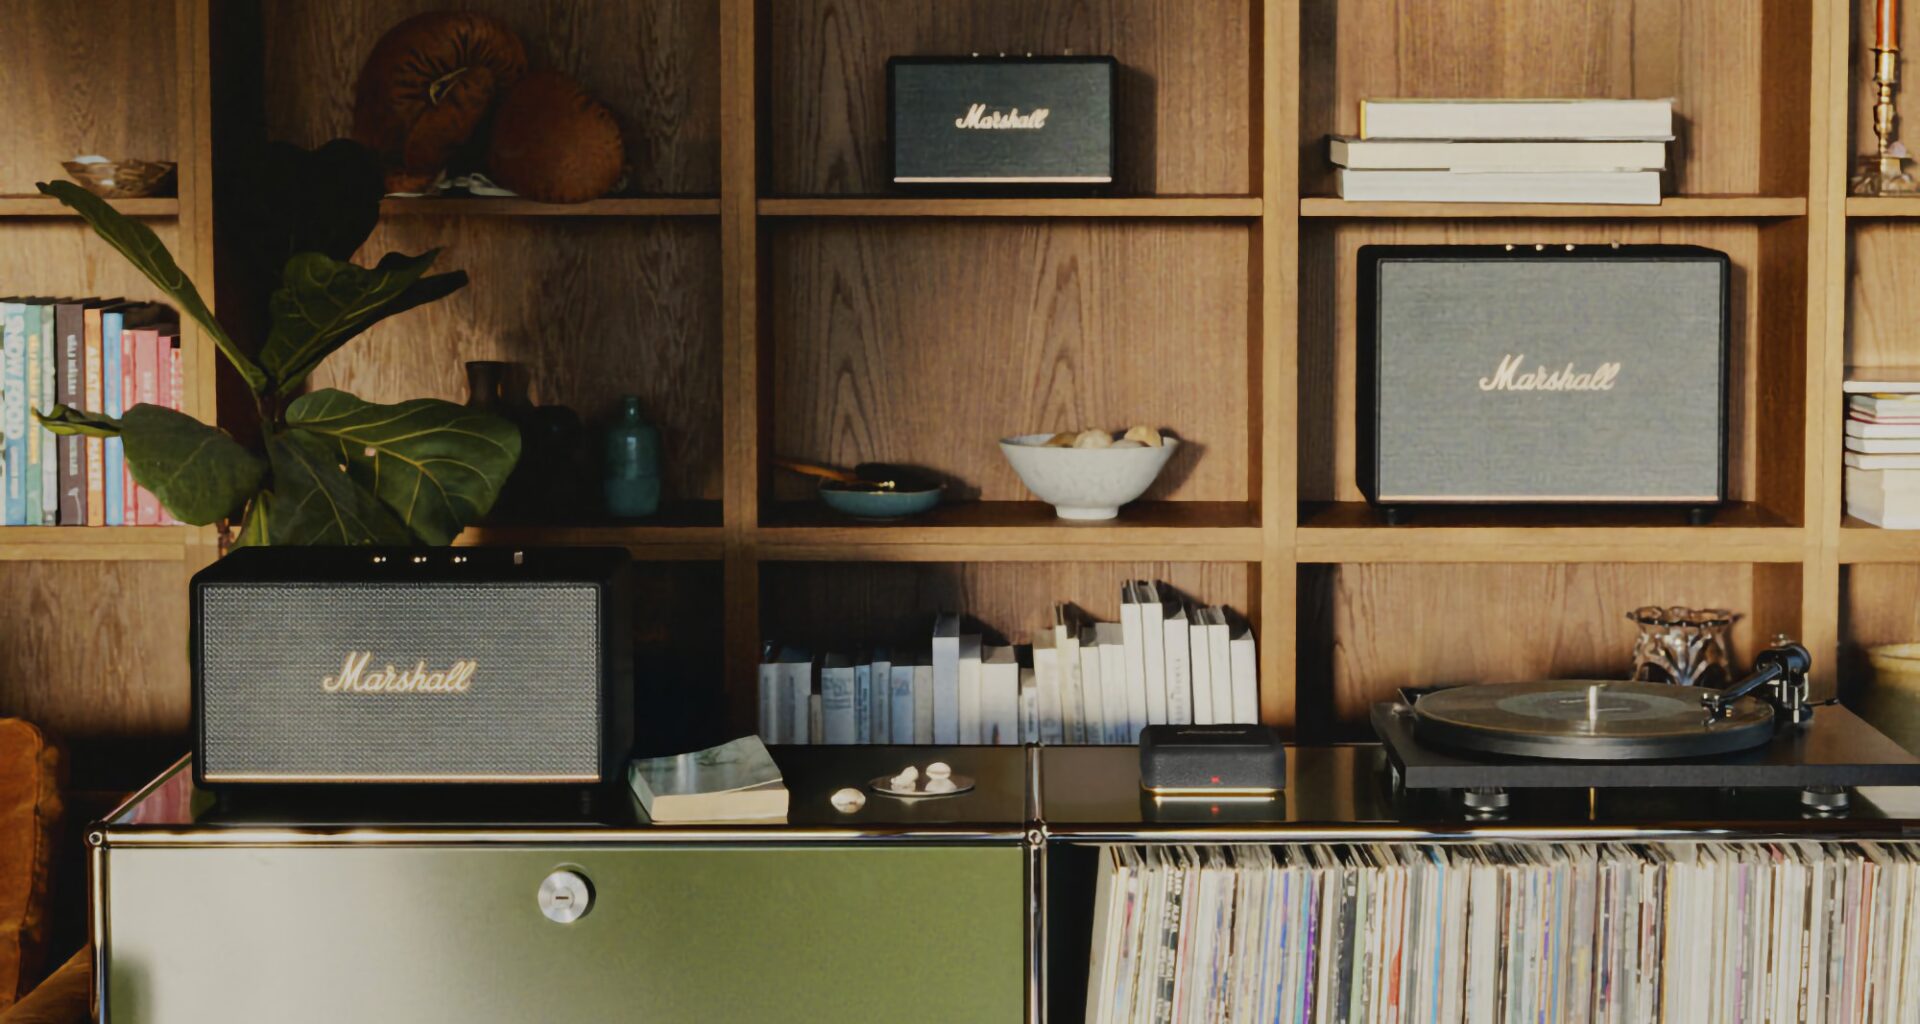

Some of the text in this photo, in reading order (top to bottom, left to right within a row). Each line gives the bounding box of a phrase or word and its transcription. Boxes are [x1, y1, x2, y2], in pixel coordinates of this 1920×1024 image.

[955, 103, 1049, 129] Marshall
[1479, 353, 1621, 391] Marshall
[5, 379, 25, 440] FOOD
[323, 651, 477, 692] Marshall
